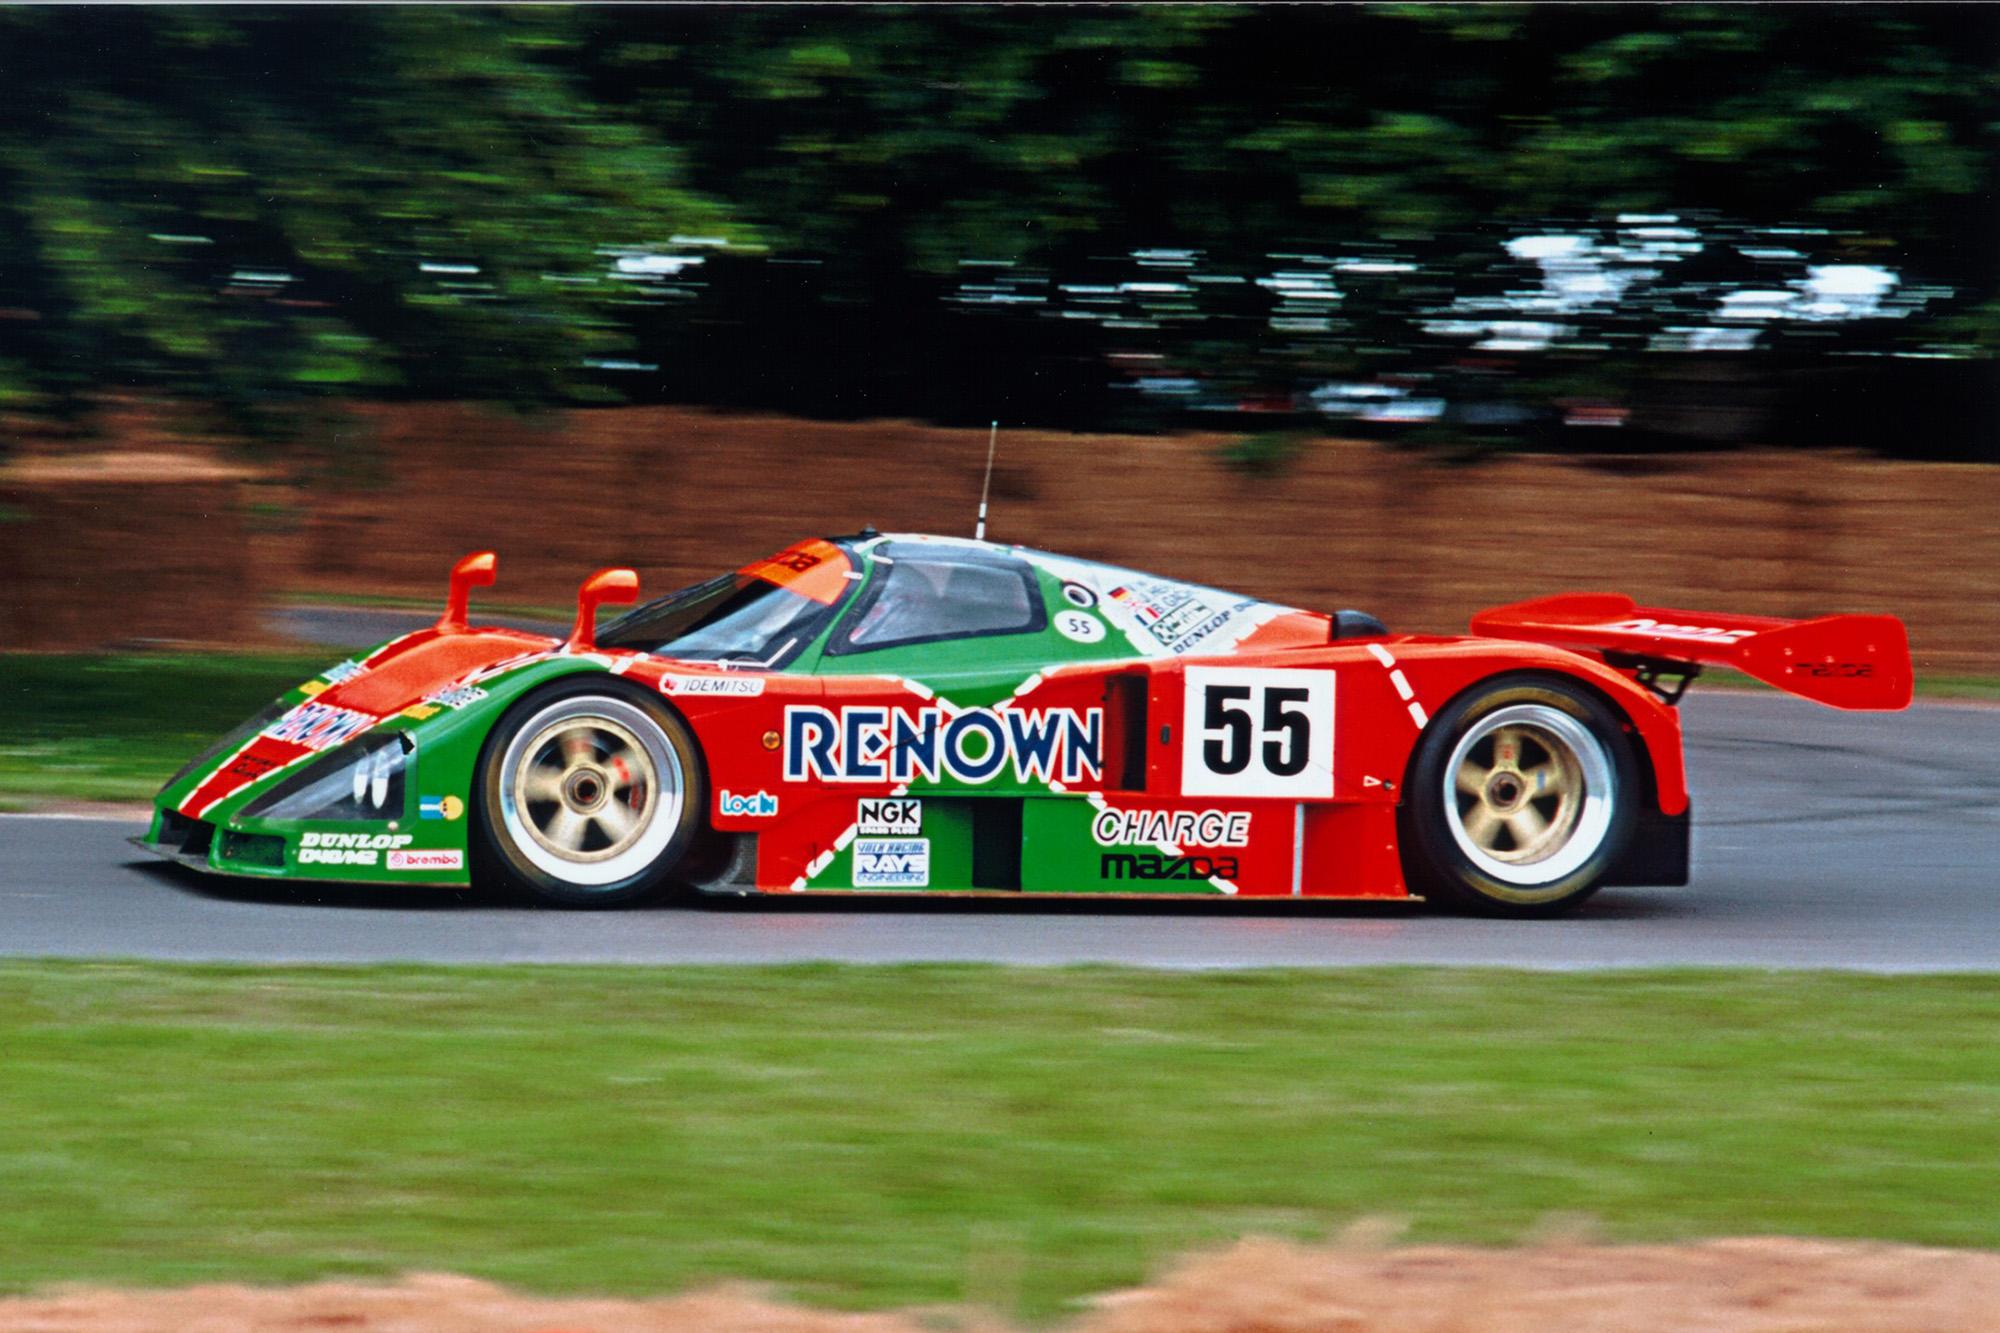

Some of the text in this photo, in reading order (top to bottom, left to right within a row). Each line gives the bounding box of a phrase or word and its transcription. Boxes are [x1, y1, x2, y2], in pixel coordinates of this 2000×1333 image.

[1068, 618, 1092, 635] 55
[1172, 610, 1231, 654] DUNLOP
[683, 679, 760, 693] IDEMITSU
[1203, 685, 1310, 776] 55
[783, 705, 1103, 783] RENOWN
[861, 801, 918, 824] NGK
[299, 832, 414, 848] DUNLOP
[1093, 811, 1250, 846] CHARGE
[406, 854, 458, 865] brembo
[1101, 853, 1239, 880] mazda
